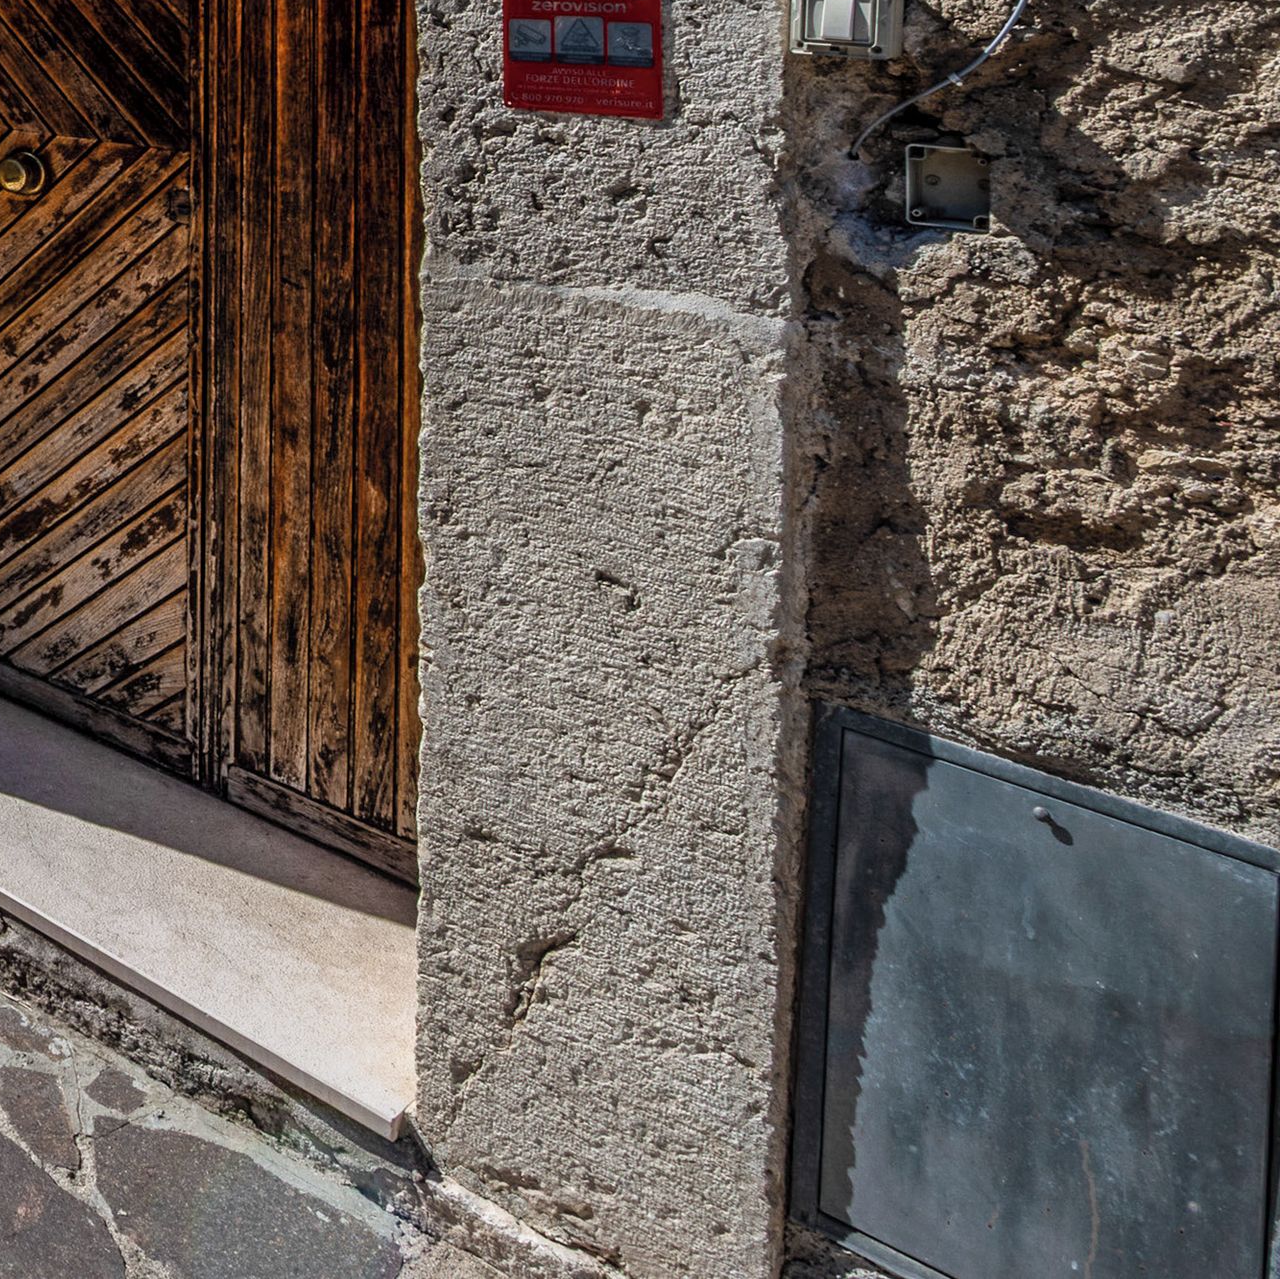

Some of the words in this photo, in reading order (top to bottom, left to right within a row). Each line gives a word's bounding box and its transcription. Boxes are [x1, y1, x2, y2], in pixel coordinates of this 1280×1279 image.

[531, 0, 627, 14] zerovision
[552, 67, 584, 76] AVVISO
[586, 69, 606, 77] ALLE
[526, 73, 559, 84] FORZE
[562, 77, 635, 89] DELL'ORDINE
[522, 92, 542, 102] 800
[545, 94, 563, 103] 970
[566, 96, 584, 105] 970
[596, 97, 654, 109] verisure.it
